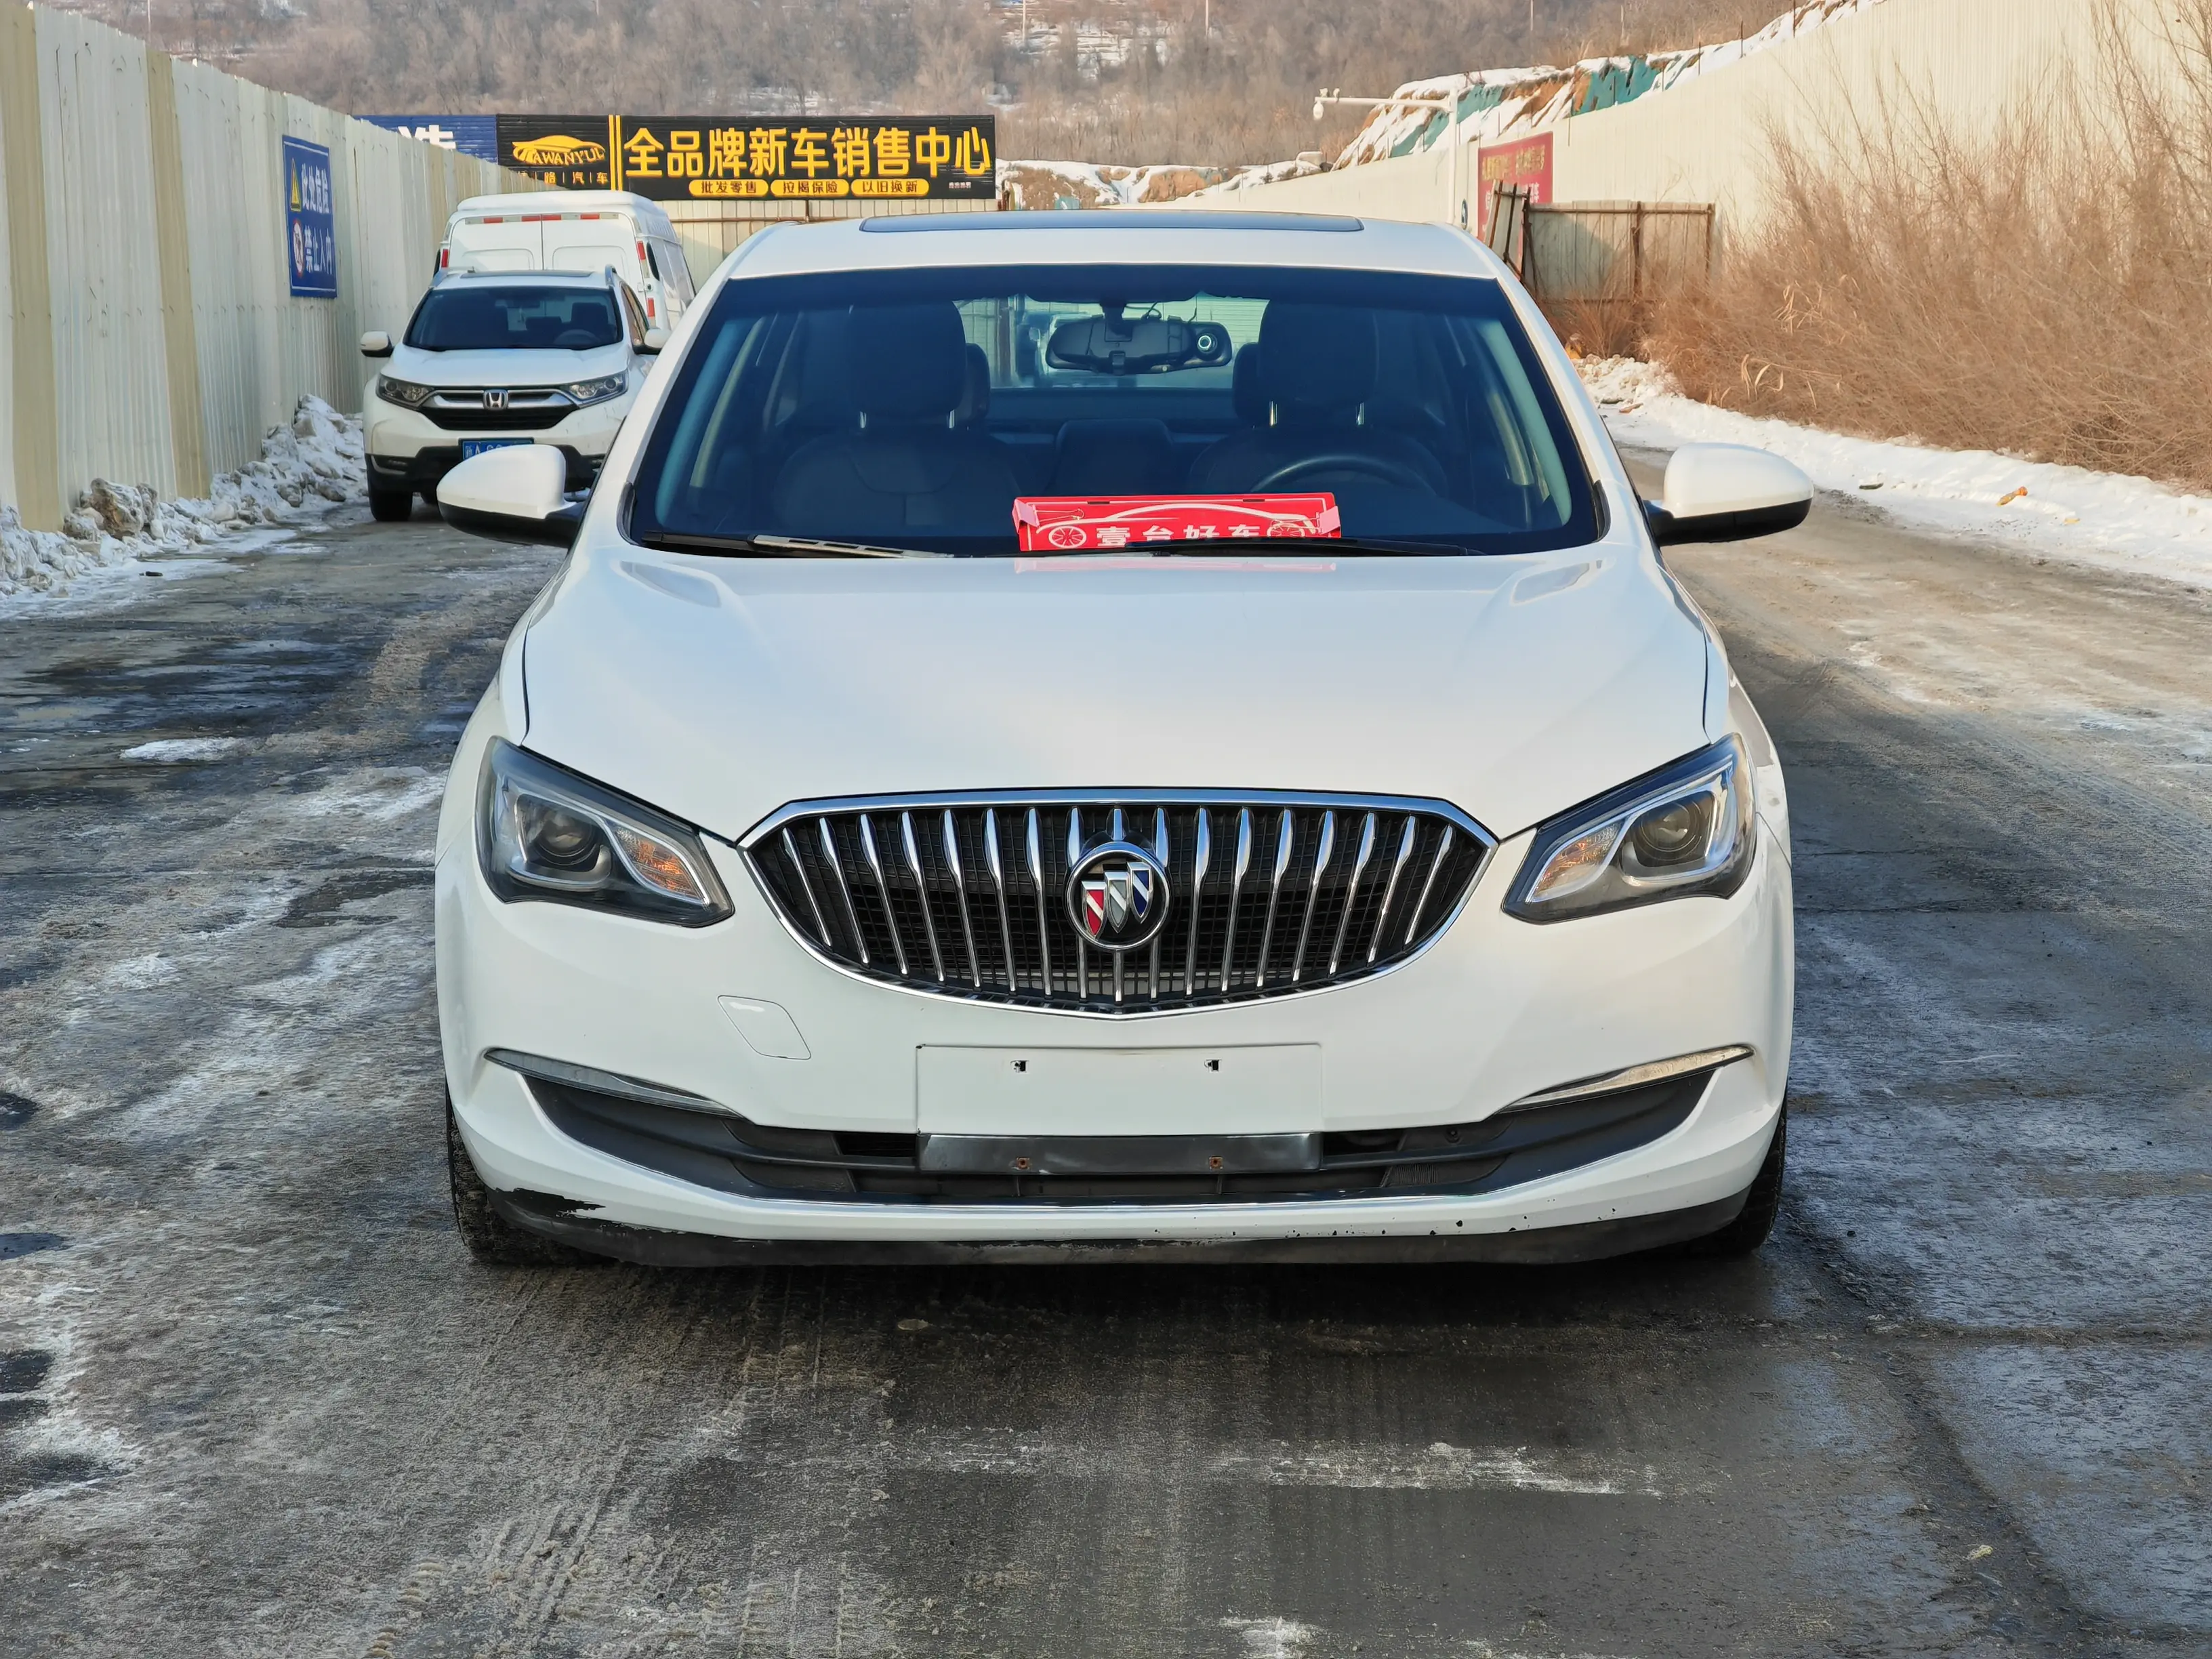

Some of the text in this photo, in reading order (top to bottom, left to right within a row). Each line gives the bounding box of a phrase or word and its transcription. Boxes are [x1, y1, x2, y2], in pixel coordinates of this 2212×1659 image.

[623, 126, 991, 178] 全品牌新车销售中心
[301, 163, 330, 214] 此处危险
[701, 181, 757, 194] 批发零售
[783, 181, 838, 194] 按揭保险
[862, 180, 918, 193] 以旧换新
[304, 224, 332, 274] 禁止入内
[1096, 524, 1261, 548] 壹台好车
